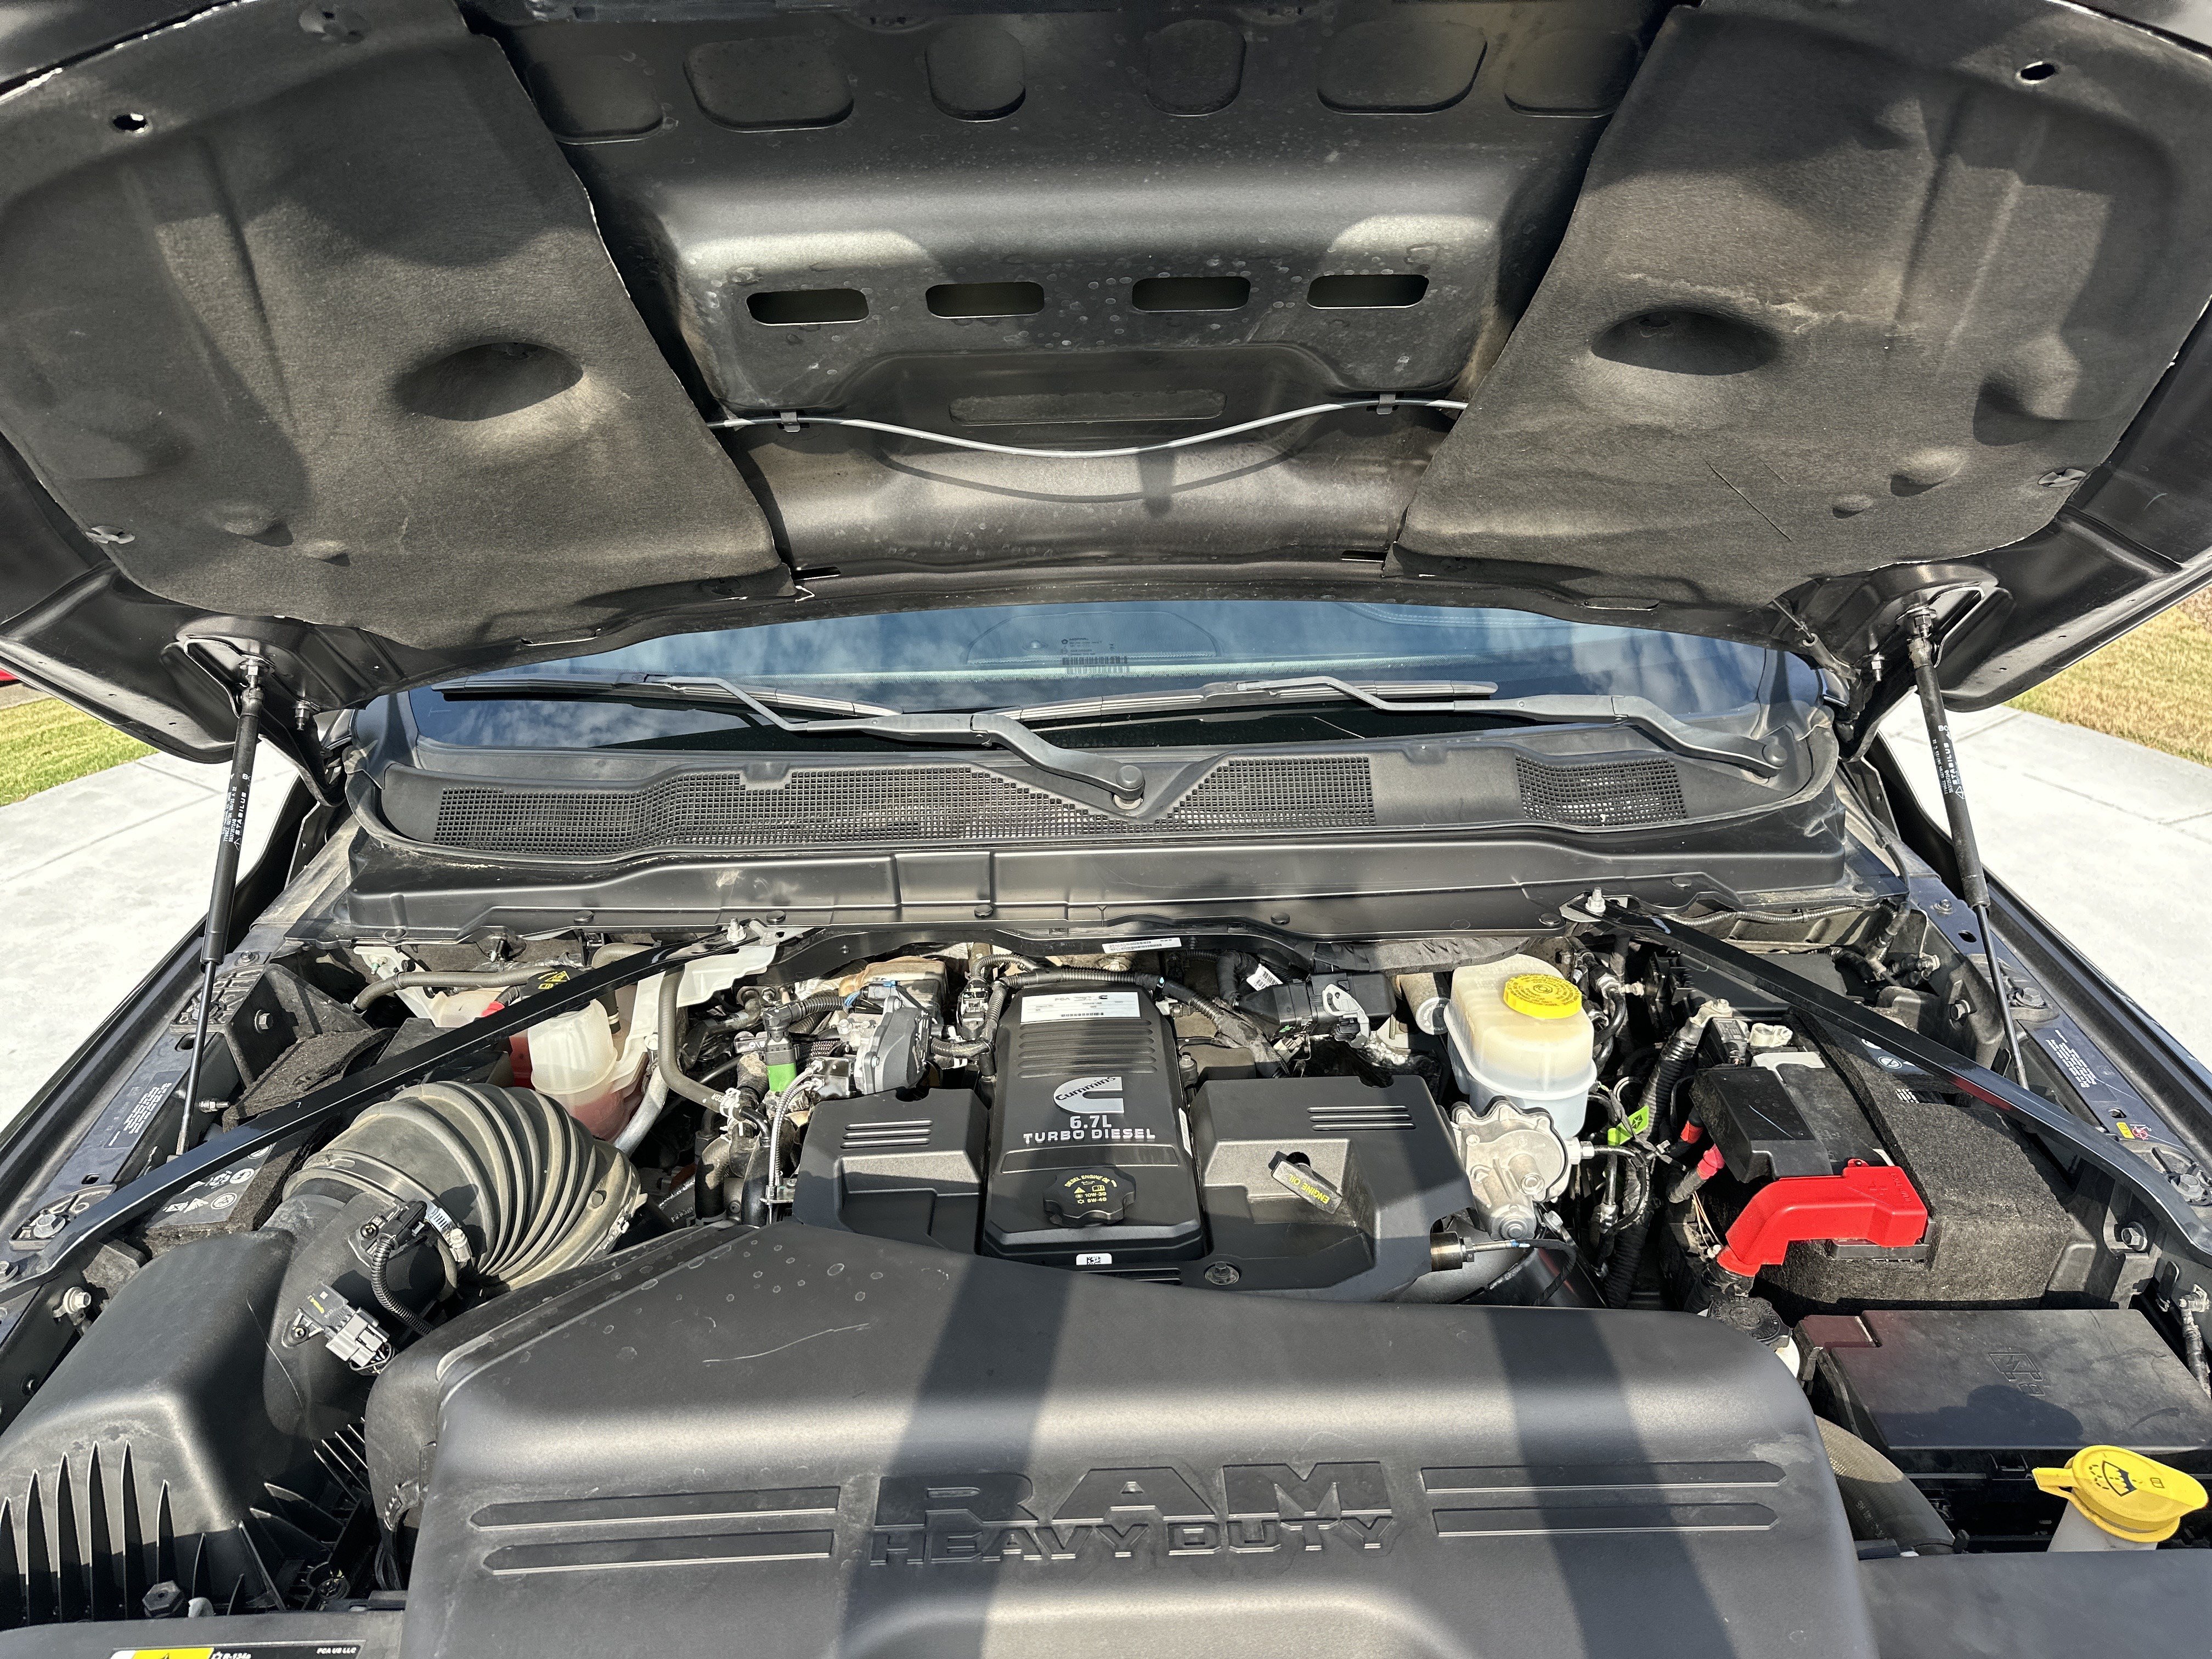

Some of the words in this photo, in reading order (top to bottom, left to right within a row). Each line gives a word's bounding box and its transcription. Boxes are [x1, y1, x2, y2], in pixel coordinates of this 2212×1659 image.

[235, 792, 247, 836] STABILUS
[1055, 1076, 1116, 1101] Cummins
[1070, 1115, 1112, 1129] 6.7L
[1023, 1130, 1085, 1144] TURBO
[1091, 1128, 1156, 1141] DIESEL
[1289, 1173, 1301, 1186] OIL
[1301, 1182, 1330, 1204] ENGINE
[874, 1461, 1393, 1528] RAM
[869, 1523, 1149, 1566] HEAVY
[1167, 1516, 1394, 1556] DUTY
